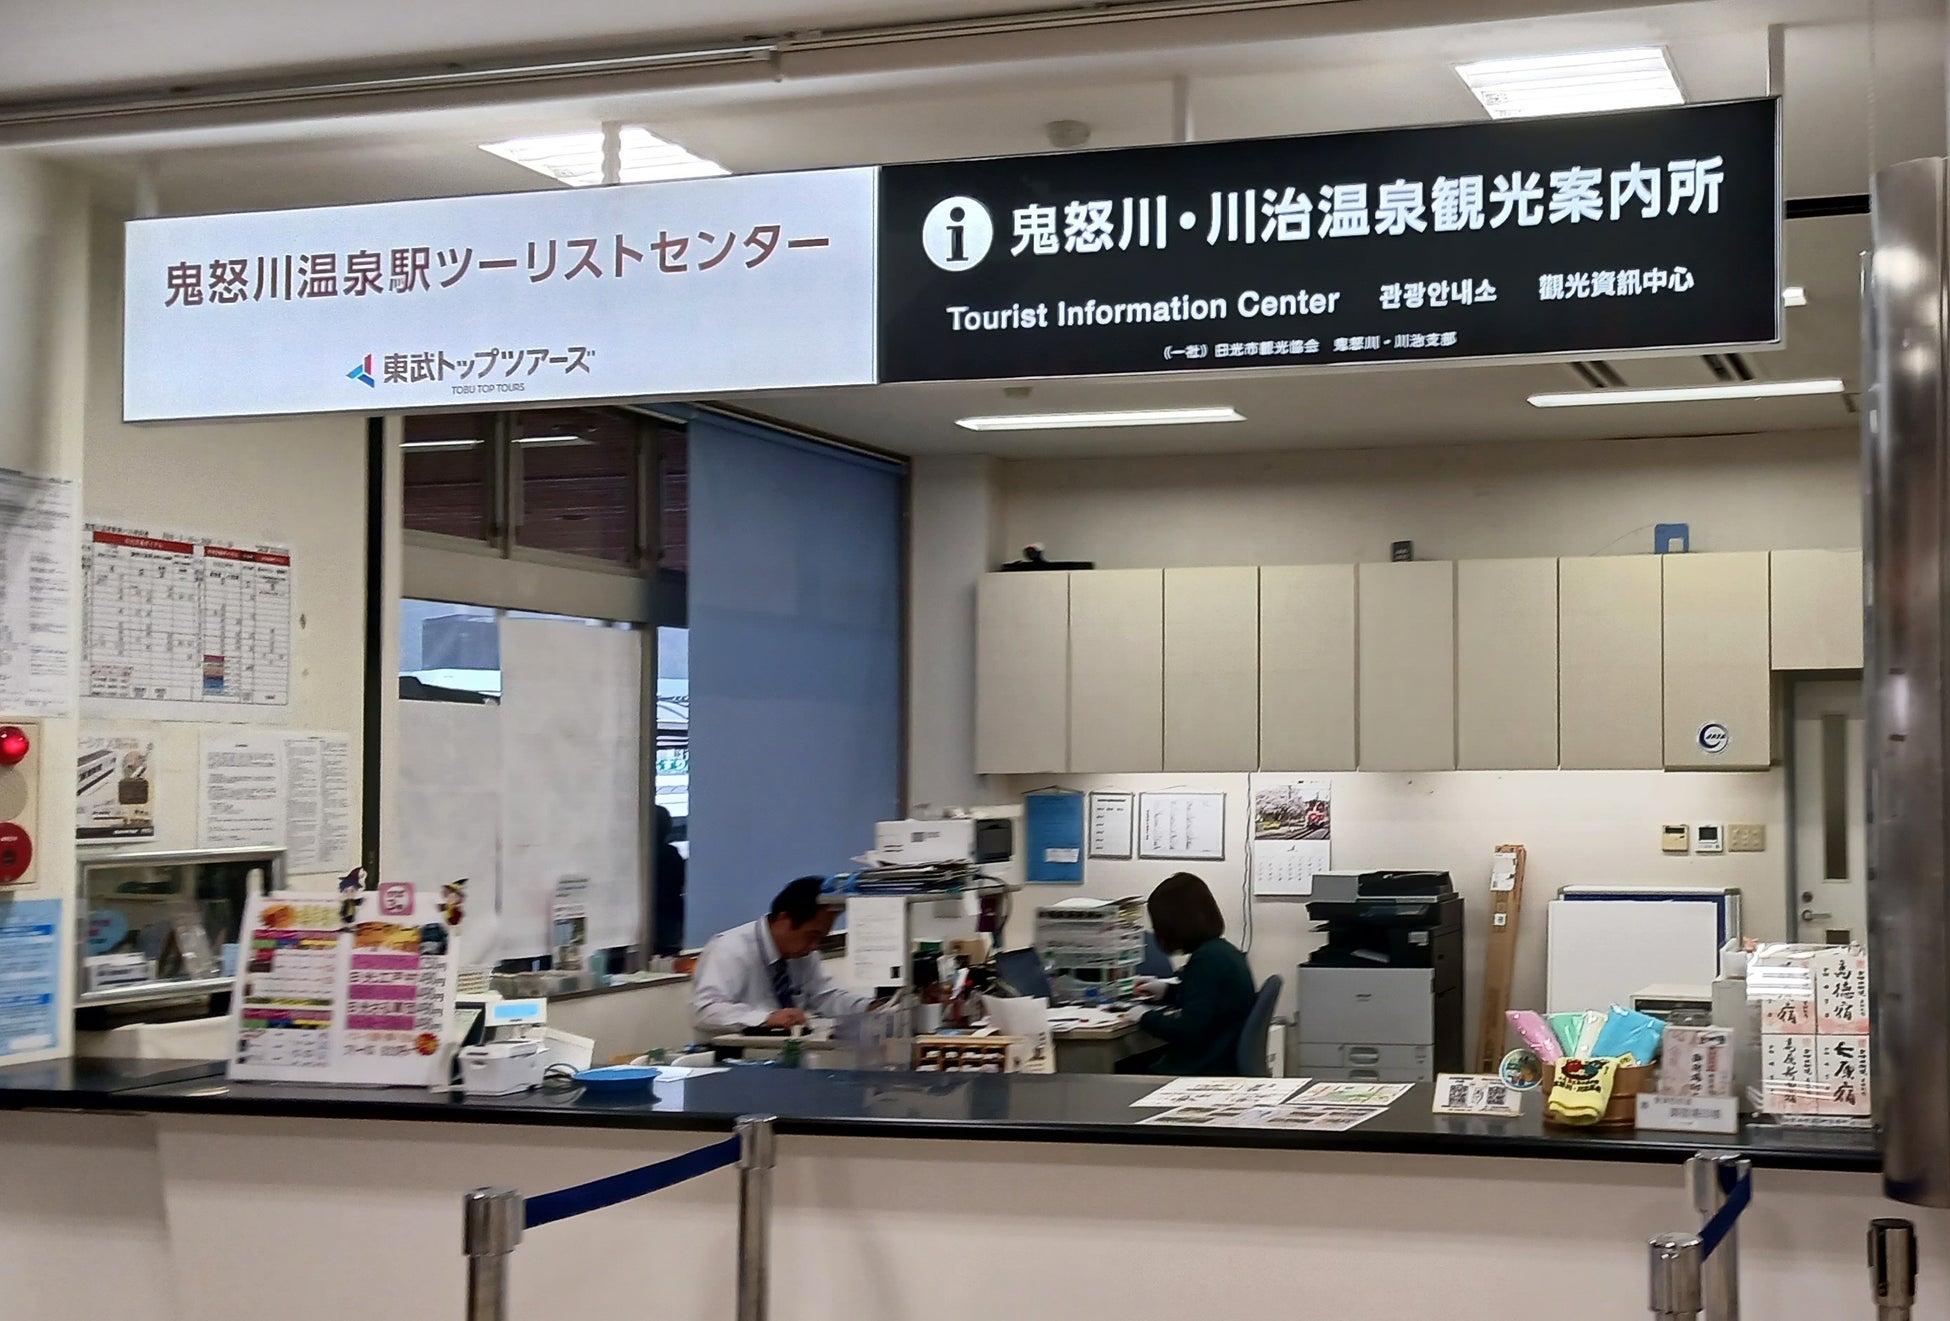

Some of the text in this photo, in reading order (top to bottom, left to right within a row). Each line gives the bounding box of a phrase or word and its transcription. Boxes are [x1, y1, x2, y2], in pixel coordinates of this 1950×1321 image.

[1010, 155, 1724, 258] 鬼怒川・川治温泉観光案内所
[164, 225, 830, 308] 鬼怒川温泉駅ツーリストセンター
[1538, 266, 1695, 301] 觀光資訊中心
[946, 289, 1341, 331] Tourist Information Center
[1379, 278, 1498, 310] 관광안내소
[383, 346, 596, 383] 東武トップツアーズ
[451, 383, 526, 395] TOBU TOP TOURS
